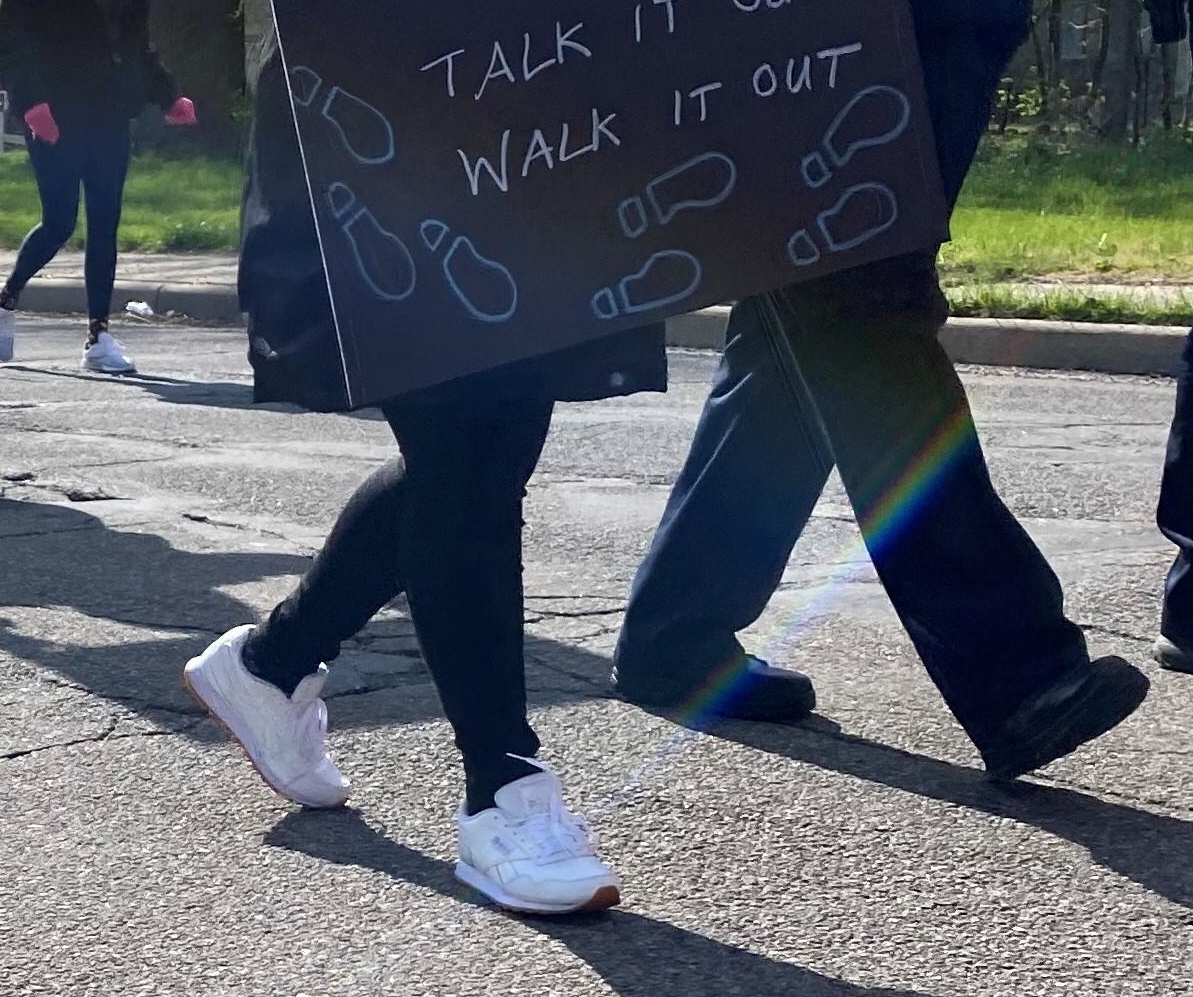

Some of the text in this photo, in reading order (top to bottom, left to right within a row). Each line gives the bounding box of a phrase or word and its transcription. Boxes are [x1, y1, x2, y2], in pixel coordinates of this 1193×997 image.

[420, 21, 593, 101] TALK
[457, 42, 863, 195] WALK IT OUT
